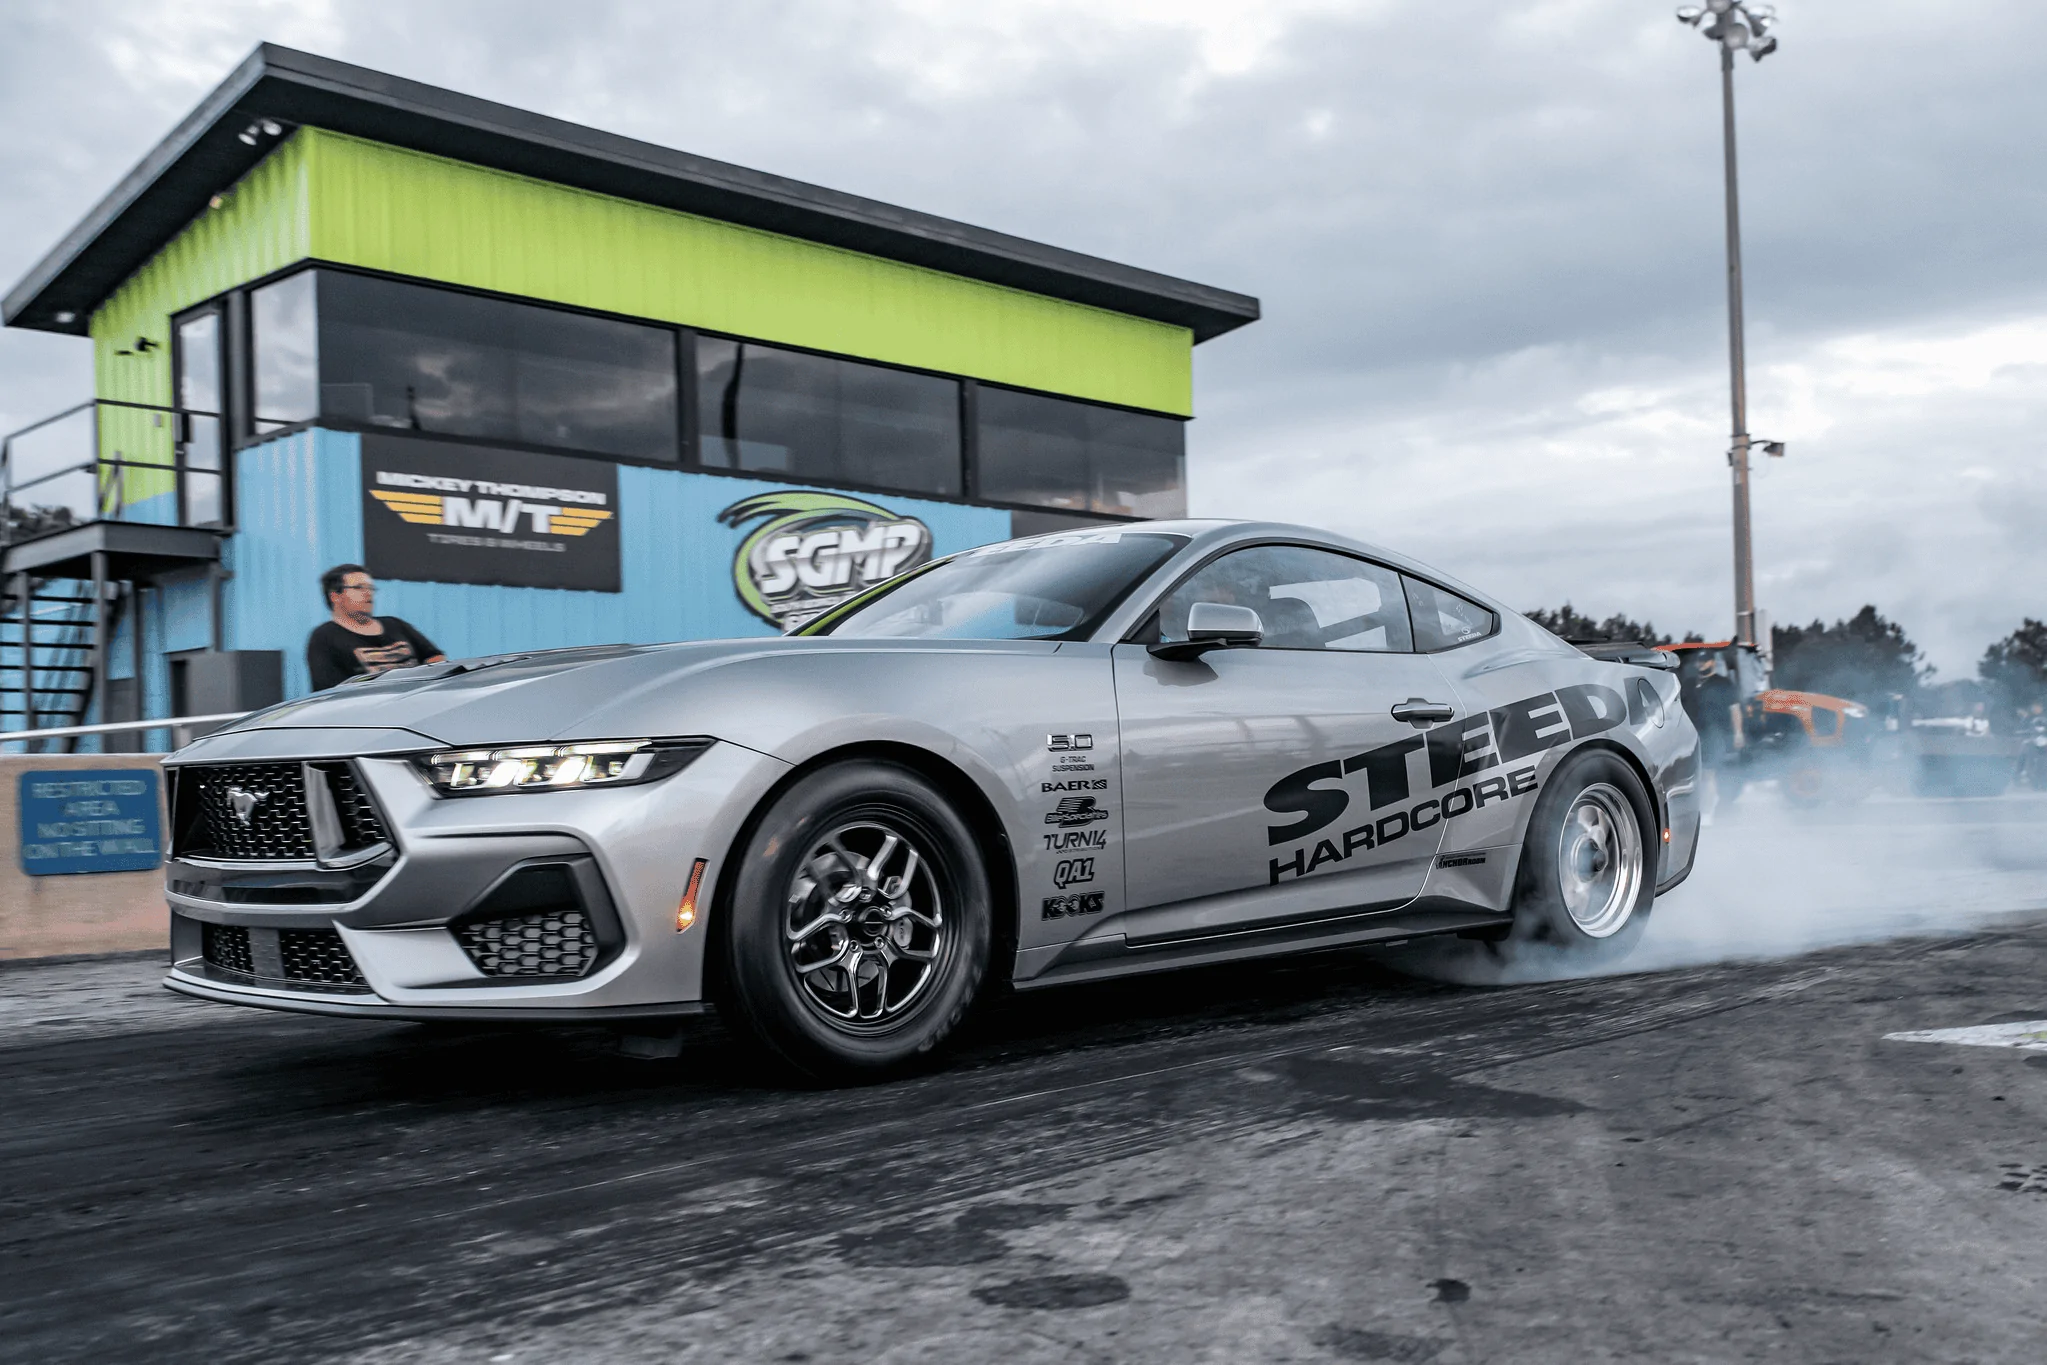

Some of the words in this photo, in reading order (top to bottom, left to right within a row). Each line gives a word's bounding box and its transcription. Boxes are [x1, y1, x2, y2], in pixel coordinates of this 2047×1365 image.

[375, 471, 472, 493] MICKEY
[473, 481, 607, 505] THOMPSON
[443, 496, 562, 533] M/T
[759, 522, 923, 596] SGMP
[1046, 734, 1093, 752] 5.0
[1052, 764, 1094, 772] SUSPENSION
[1263, 676, 1658, 845] STEEDA
[1041, 780, 1091, 792] BAER
[1269, 765, 1539, 886] HARDCORE
[1054, 857, 1095, 889] QA1
